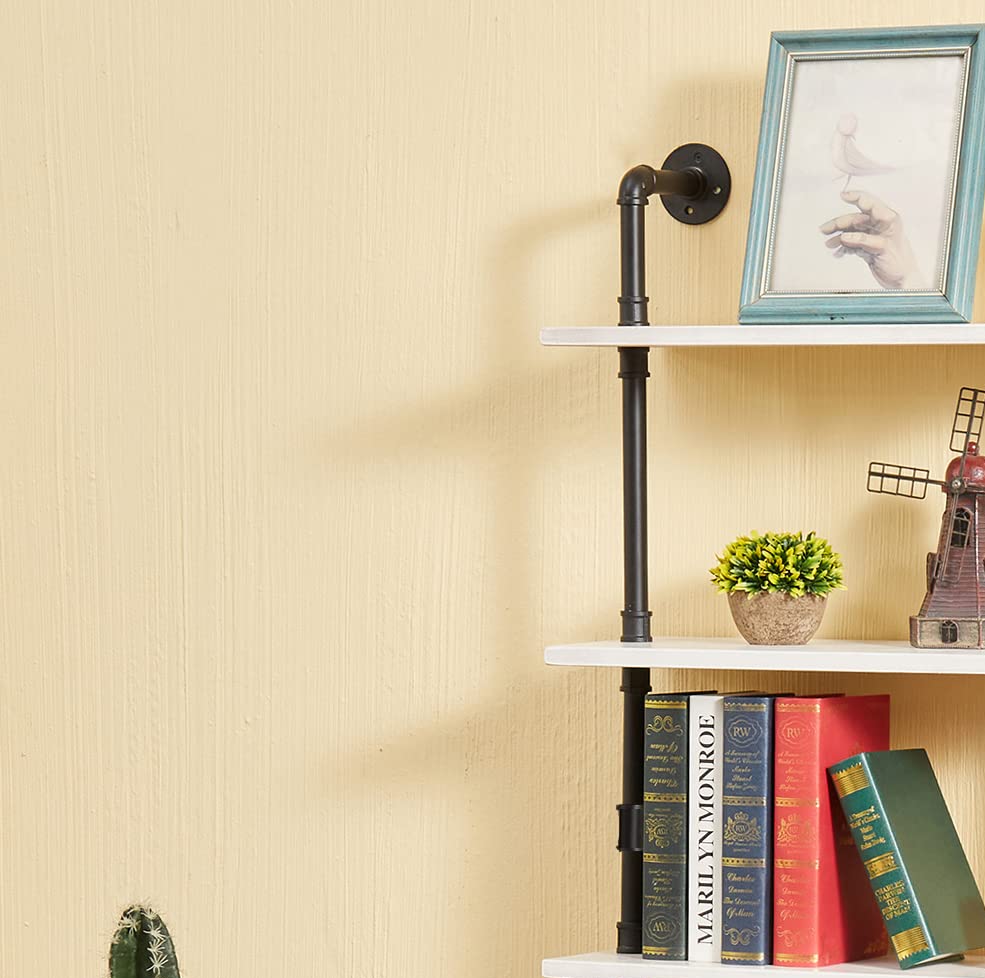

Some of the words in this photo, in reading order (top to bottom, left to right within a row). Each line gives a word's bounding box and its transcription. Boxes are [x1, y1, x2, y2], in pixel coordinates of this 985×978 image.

[698, 715, 716, 823] MONROE
[732, 726, 751, 737] RW
[698, 830, 713, 945] MARILYN
